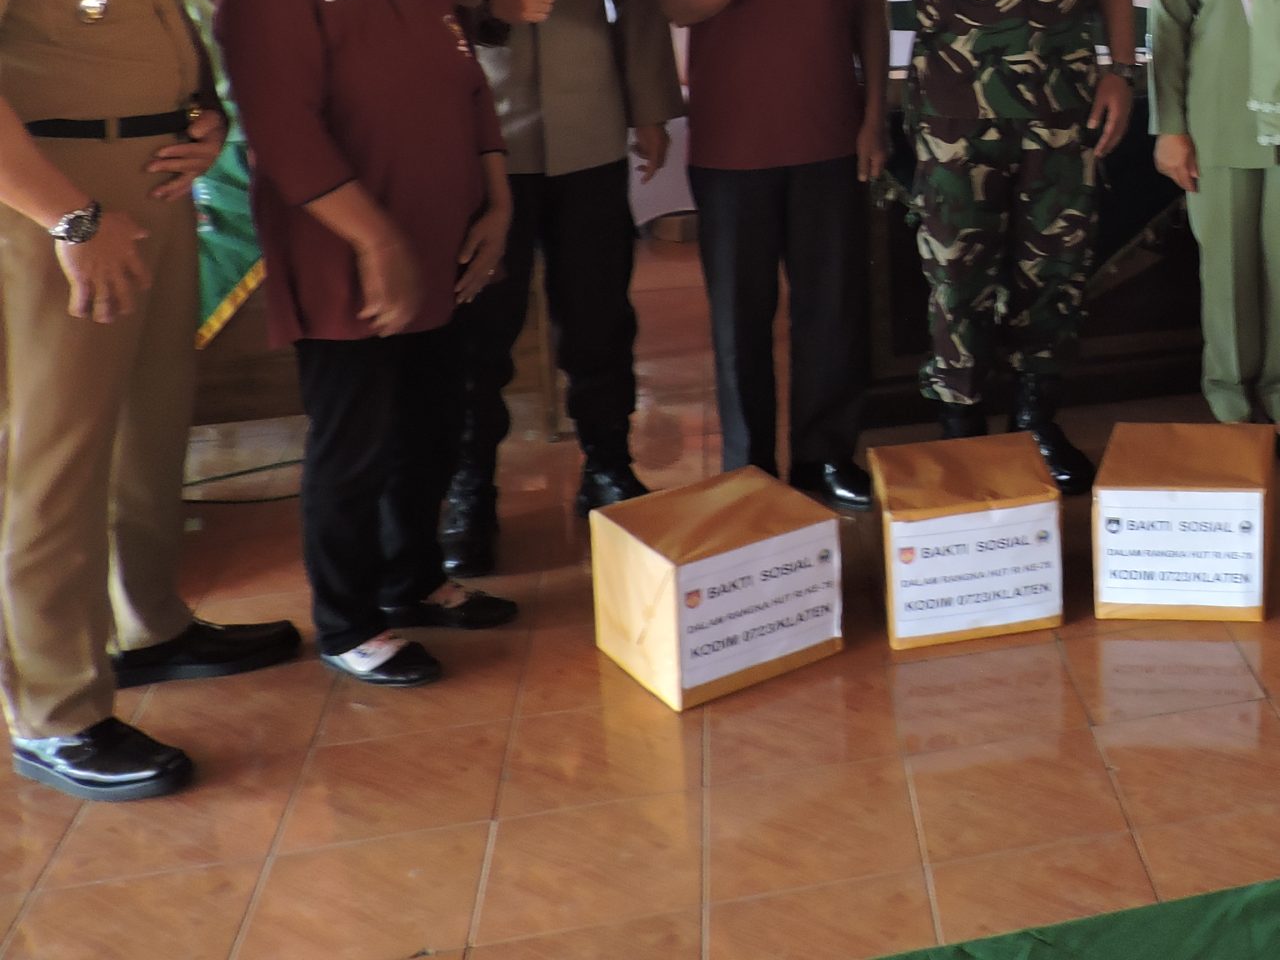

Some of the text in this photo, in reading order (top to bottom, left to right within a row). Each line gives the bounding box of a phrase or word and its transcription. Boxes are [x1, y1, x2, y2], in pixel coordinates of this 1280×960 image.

[1127, 520, 1234, 533] BAKTI SOSIAL
[920, 536, 1031, 559] BAKTI SOSIAL
[707, 557, 814, 599] BAKTI SOSIAL
[1109, 569, 1155, 581] KODIM
[904, 596, 953, 612] KODIM
[690, 635, 738, 658] KODIM
